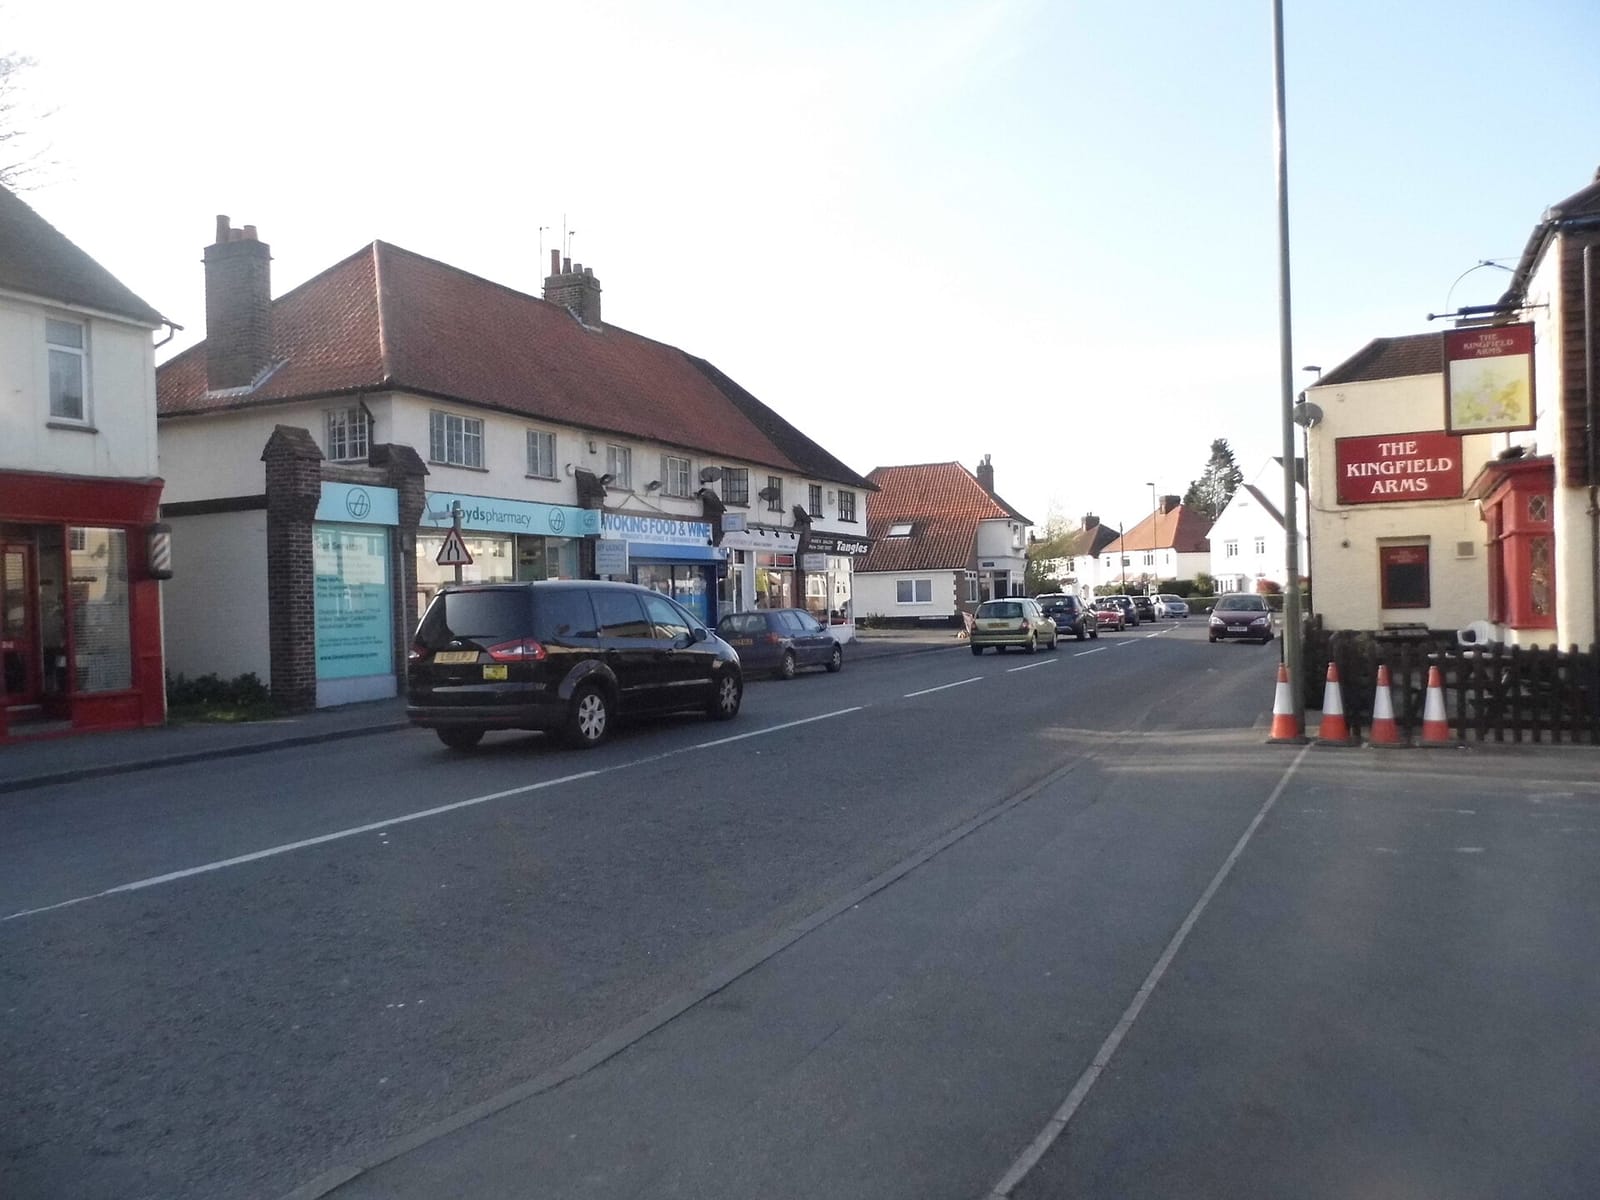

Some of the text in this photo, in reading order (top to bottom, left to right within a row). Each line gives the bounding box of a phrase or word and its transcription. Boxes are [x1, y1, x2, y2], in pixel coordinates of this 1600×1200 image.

[1463, 338, 1514, 350] KINGFIELD
[1479, 333, 1498, 342] THE
[1378, 441, 1417, 457] THE
[1346, 457, 1453, 477] KINGFIELD
[1370, 478, 1429, 494] ARMS
[601, 512, 649, 533] WOKING
[650, 518, 677, 535] FOOD
[678, 521, 686, 537] &
[687, 521, 710, 538] WINE
[836, 540, 868, 555] Tangles
